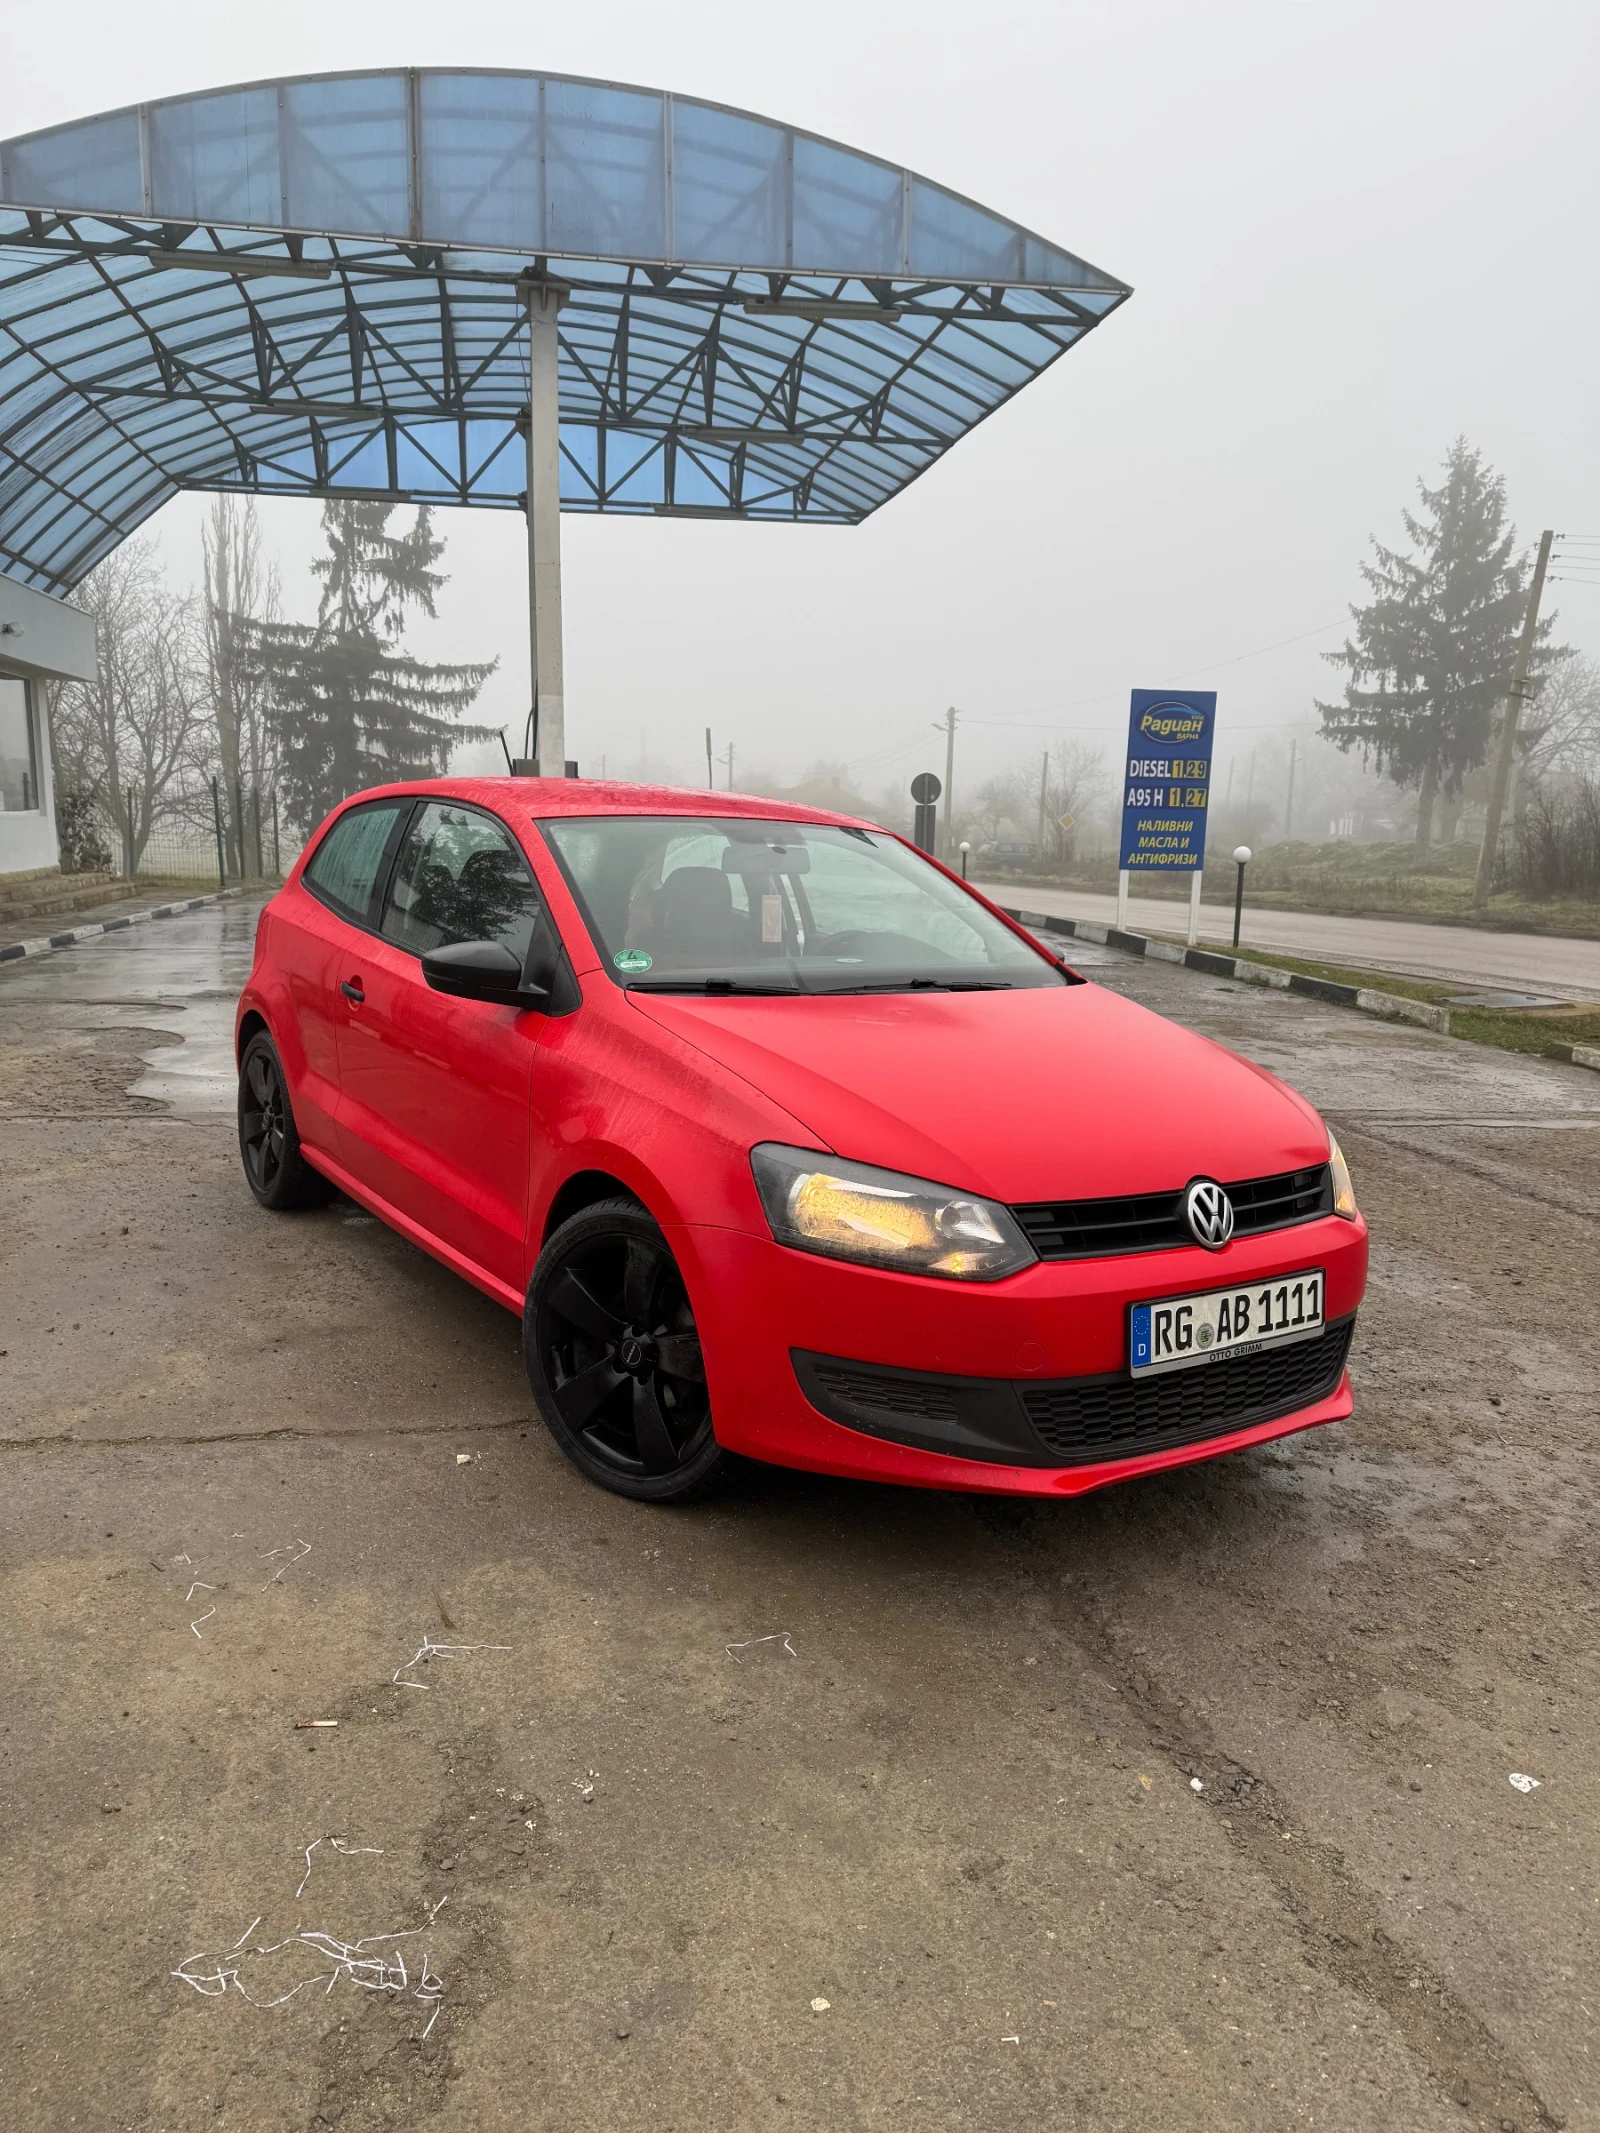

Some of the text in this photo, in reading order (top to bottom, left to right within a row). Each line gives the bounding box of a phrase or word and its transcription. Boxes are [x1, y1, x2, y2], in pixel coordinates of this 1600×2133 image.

[1176, 732, 1199, 740] ВАРНА
[1129, 760, 1171, 778] DIESEL
[1136, 820, 1193, 832] НАЛИВНИ
[1138, 837, 1190, 849] МАСЛА И
[1127, 853, 1198, 865] АНТИФРИЗИ
[1155, 1279, 1320, 1356] RG AB 1111
[1138, 1343, 1146, 1357] D
[1209, 1342, 1263, 1362] OTTO GRIMM
